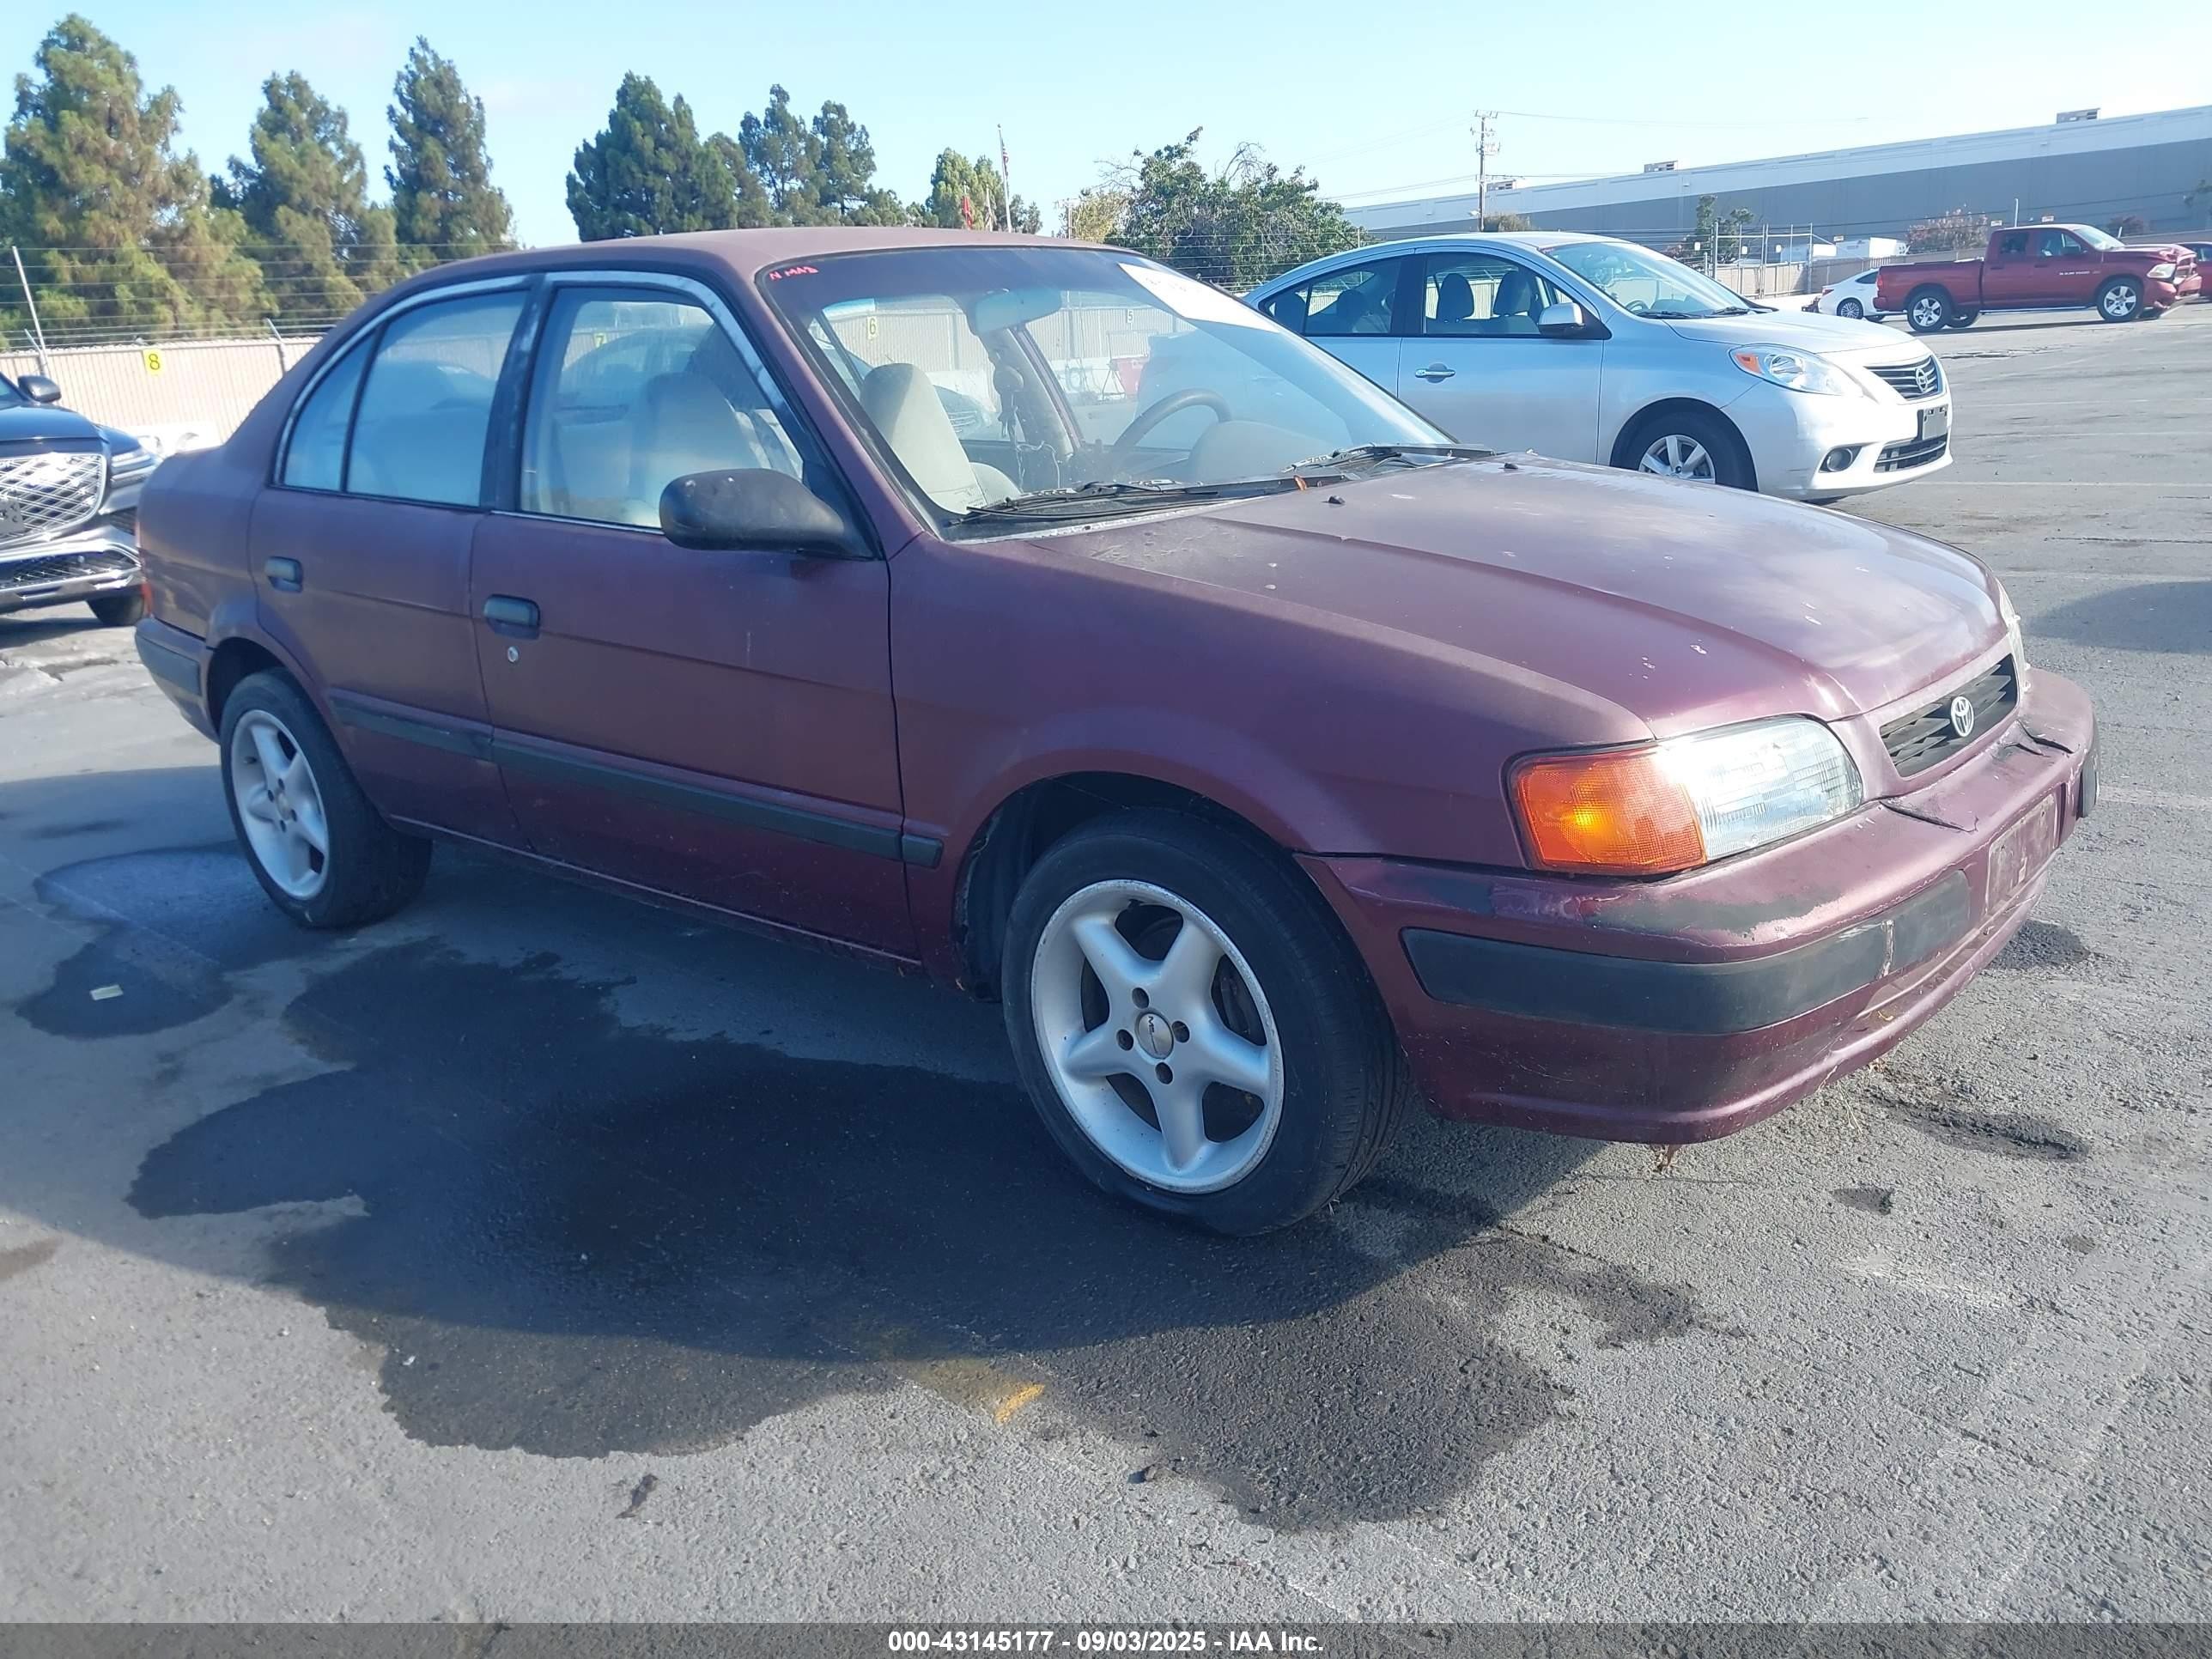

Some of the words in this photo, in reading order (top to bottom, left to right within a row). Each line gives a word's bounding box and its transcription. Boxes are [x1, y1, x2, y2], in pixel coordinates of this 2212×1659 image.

[1128, 311, 1133, 321] 5
[869, 318, 877, 335] 6
[595, 335, 605, 344] 7
[148, 353, 161, 370] 8
